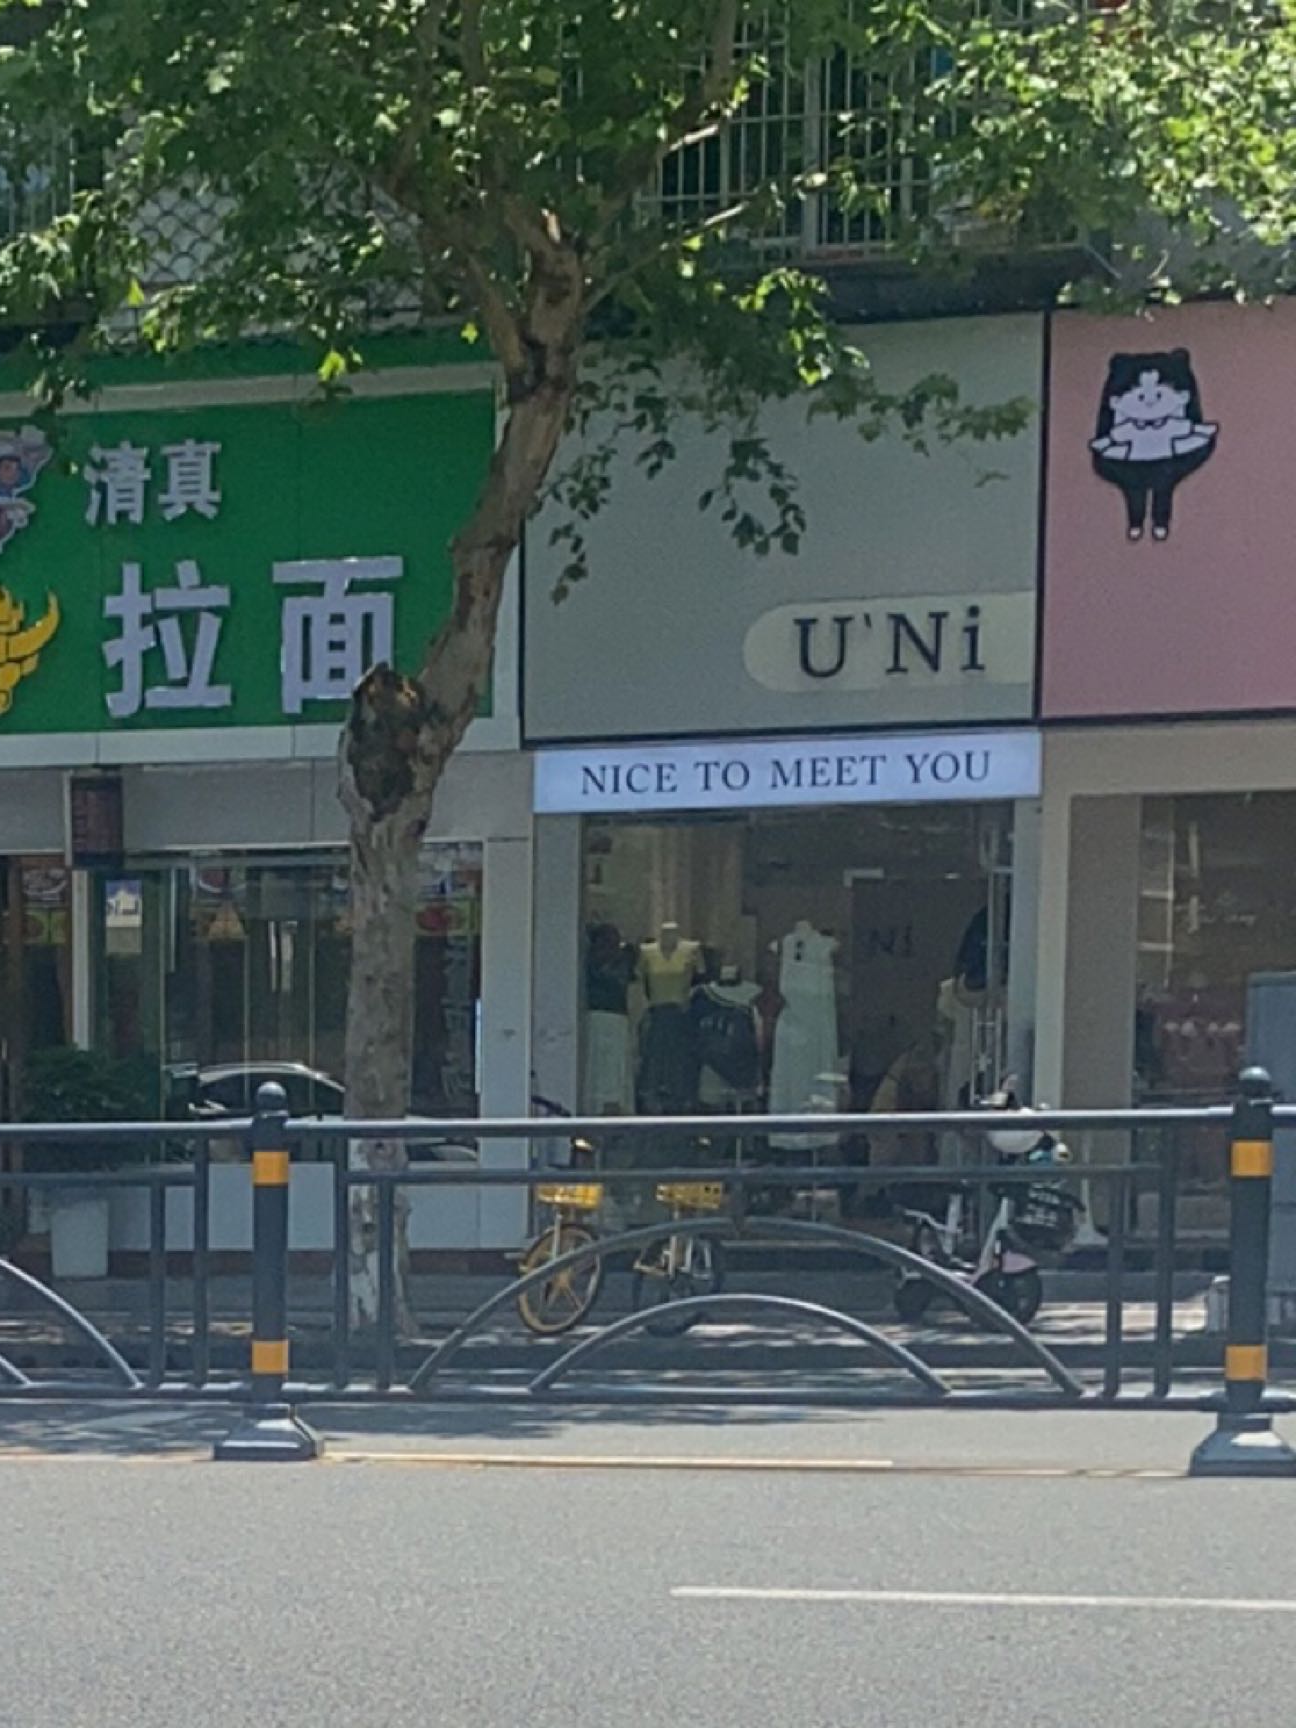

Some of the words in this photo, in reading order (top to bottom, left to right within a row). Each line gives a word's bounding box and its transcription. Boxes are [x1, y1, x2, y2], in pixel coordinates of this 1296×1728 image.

[84, 439, 223, 527] 清真
[104, 556, 404, 718] 拉面
[581, 762, 679, 796] NICE
[694, 759, 751, 792] TO
[770, 753, 887, 790] MEET
[905, 749, 993, 784] YOU
